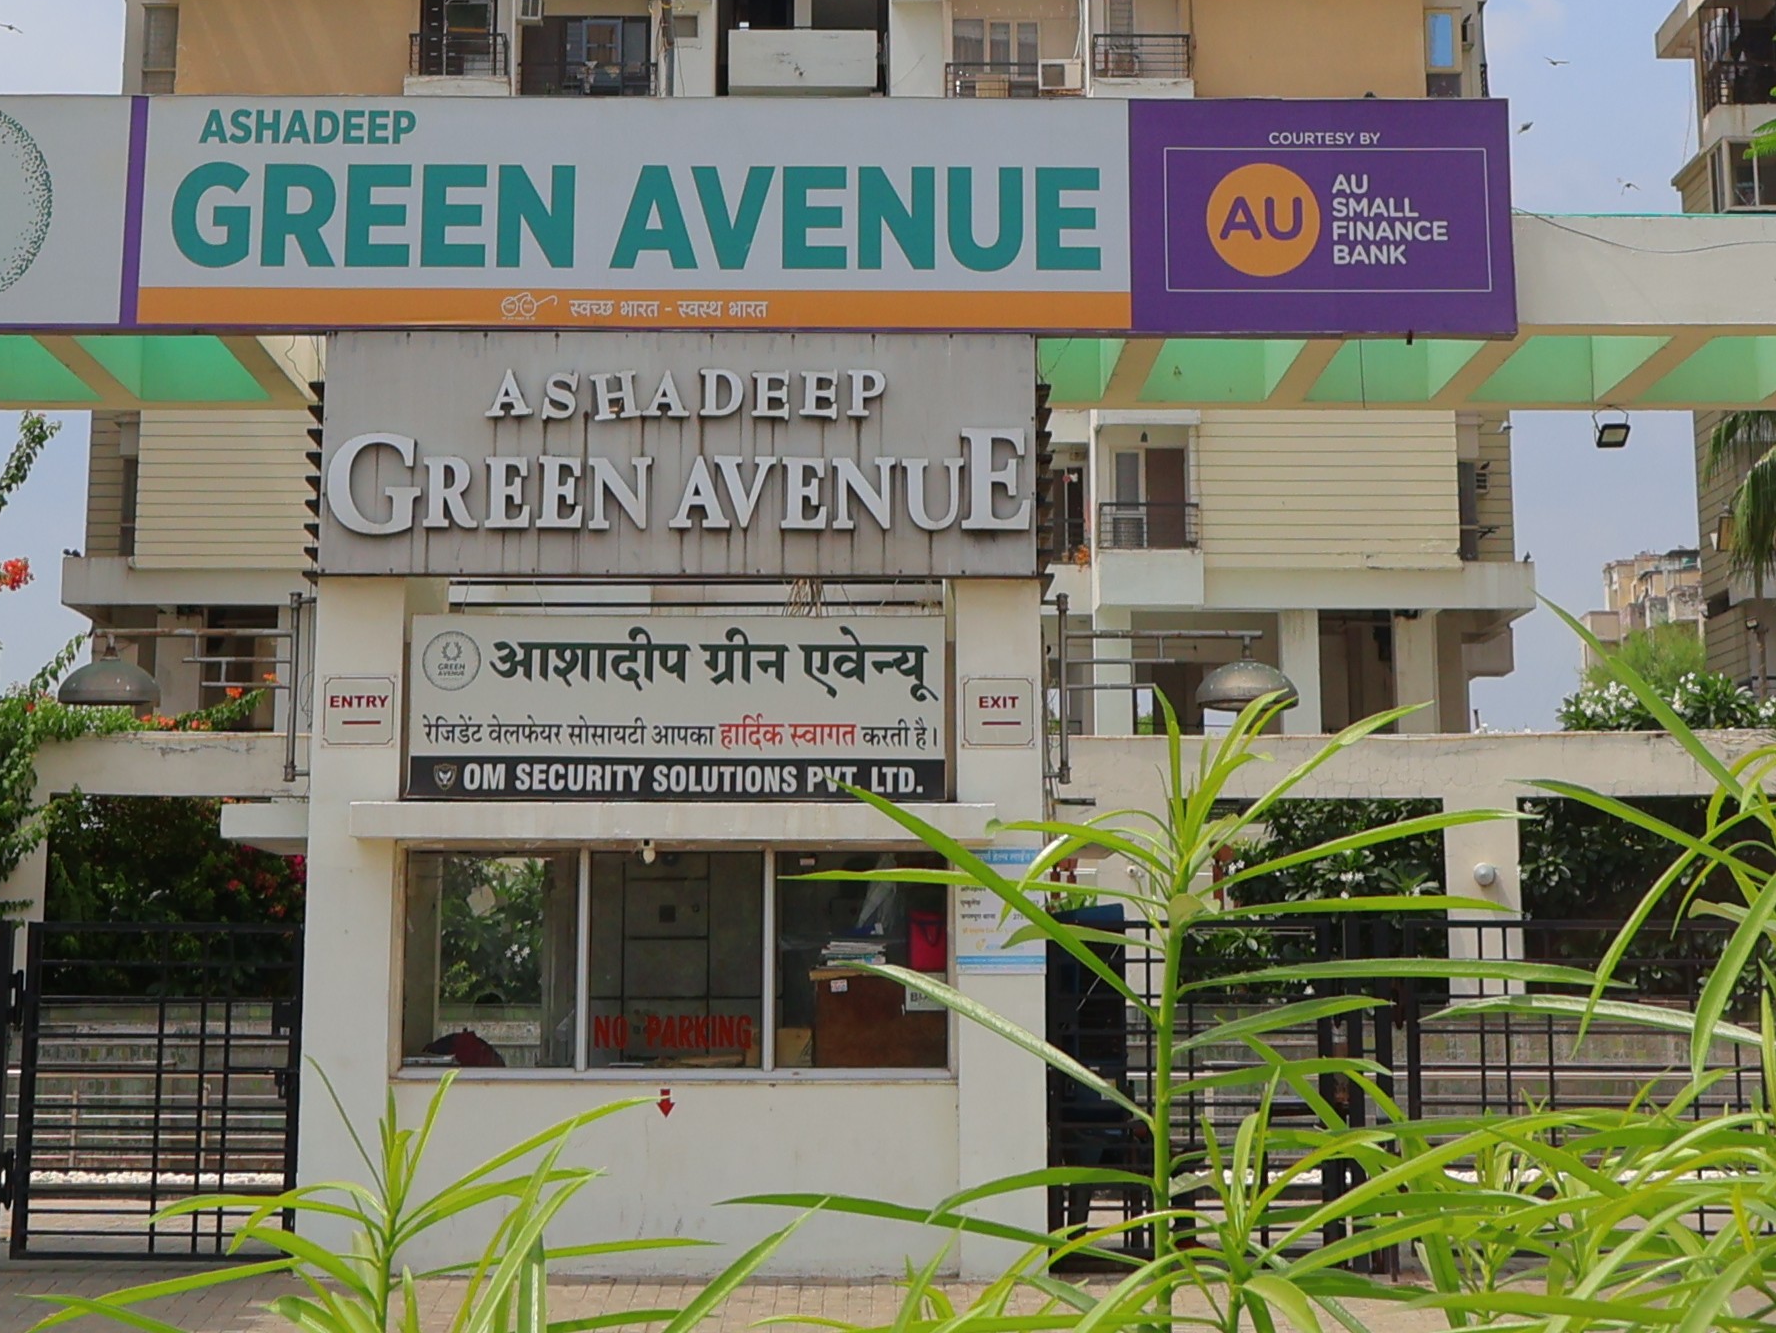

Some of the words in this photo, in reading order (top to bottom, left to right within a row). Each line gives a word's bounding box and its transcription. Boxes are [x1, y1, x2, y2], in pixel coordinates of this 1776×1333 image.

[198, 108, 417, 145] ASHADEEP
[1268, 131, 1355, 145] COURTESY
[1359, 132, 1381, 145] BY
[1331, 173, 1369, 195] AU
[170, 161, 577, 269] GREEN
[608, 164, 1102, 272] AVENUE
[1218, 195, 1304, 242] AU
[1331, 197, 1420, 218] SMALL
[1332, 220, 1449, 242] FINANCE
[1332, 244, 1408, 266] BANK
[568, 299, 615, 317] स्वच्छ
[620, 299, 660, 317] भारत
[677, 300, 723, 317] स्वस्थ
[728, 300, 769, 318] भारत
[484, 367, 887, 421] ASHADEEP
[326, 432, 654, 537] GREEN
[668, 427, 1032, 533] AVENUE
[437, 662, 466, 671] GREEN
[489, 626, 691, 691] आशादीप
[699, 626, 790, 686] ग्रीन
[797, 625, 939, 702] एवेन्यू
[328, 693, 390, 711] ENTRY
[977, 694, 1020, 711] EXIT
[422, 714, 484, 745] रेजिडेंट
[487, 714, 563, 745] वेलफेयर
[567, 715, 647, 746] सोसायटी
[651, 724, 715, 747] आपका
[719, 713, 785, 750] हार्दिक
[788, 723, 857, 747] स्वागत
[860, 719, 911, 747] करती
[463, 763, 506, 791] OM
[515, 763, 645, 793] SECURITY
[652, 764, 798, 794] SOLUTIONS
[870, 766, 924, 794] LTD.
[593, 1014, 629, 1049] NO
[644, 1013, 753, 1050] PARKING
